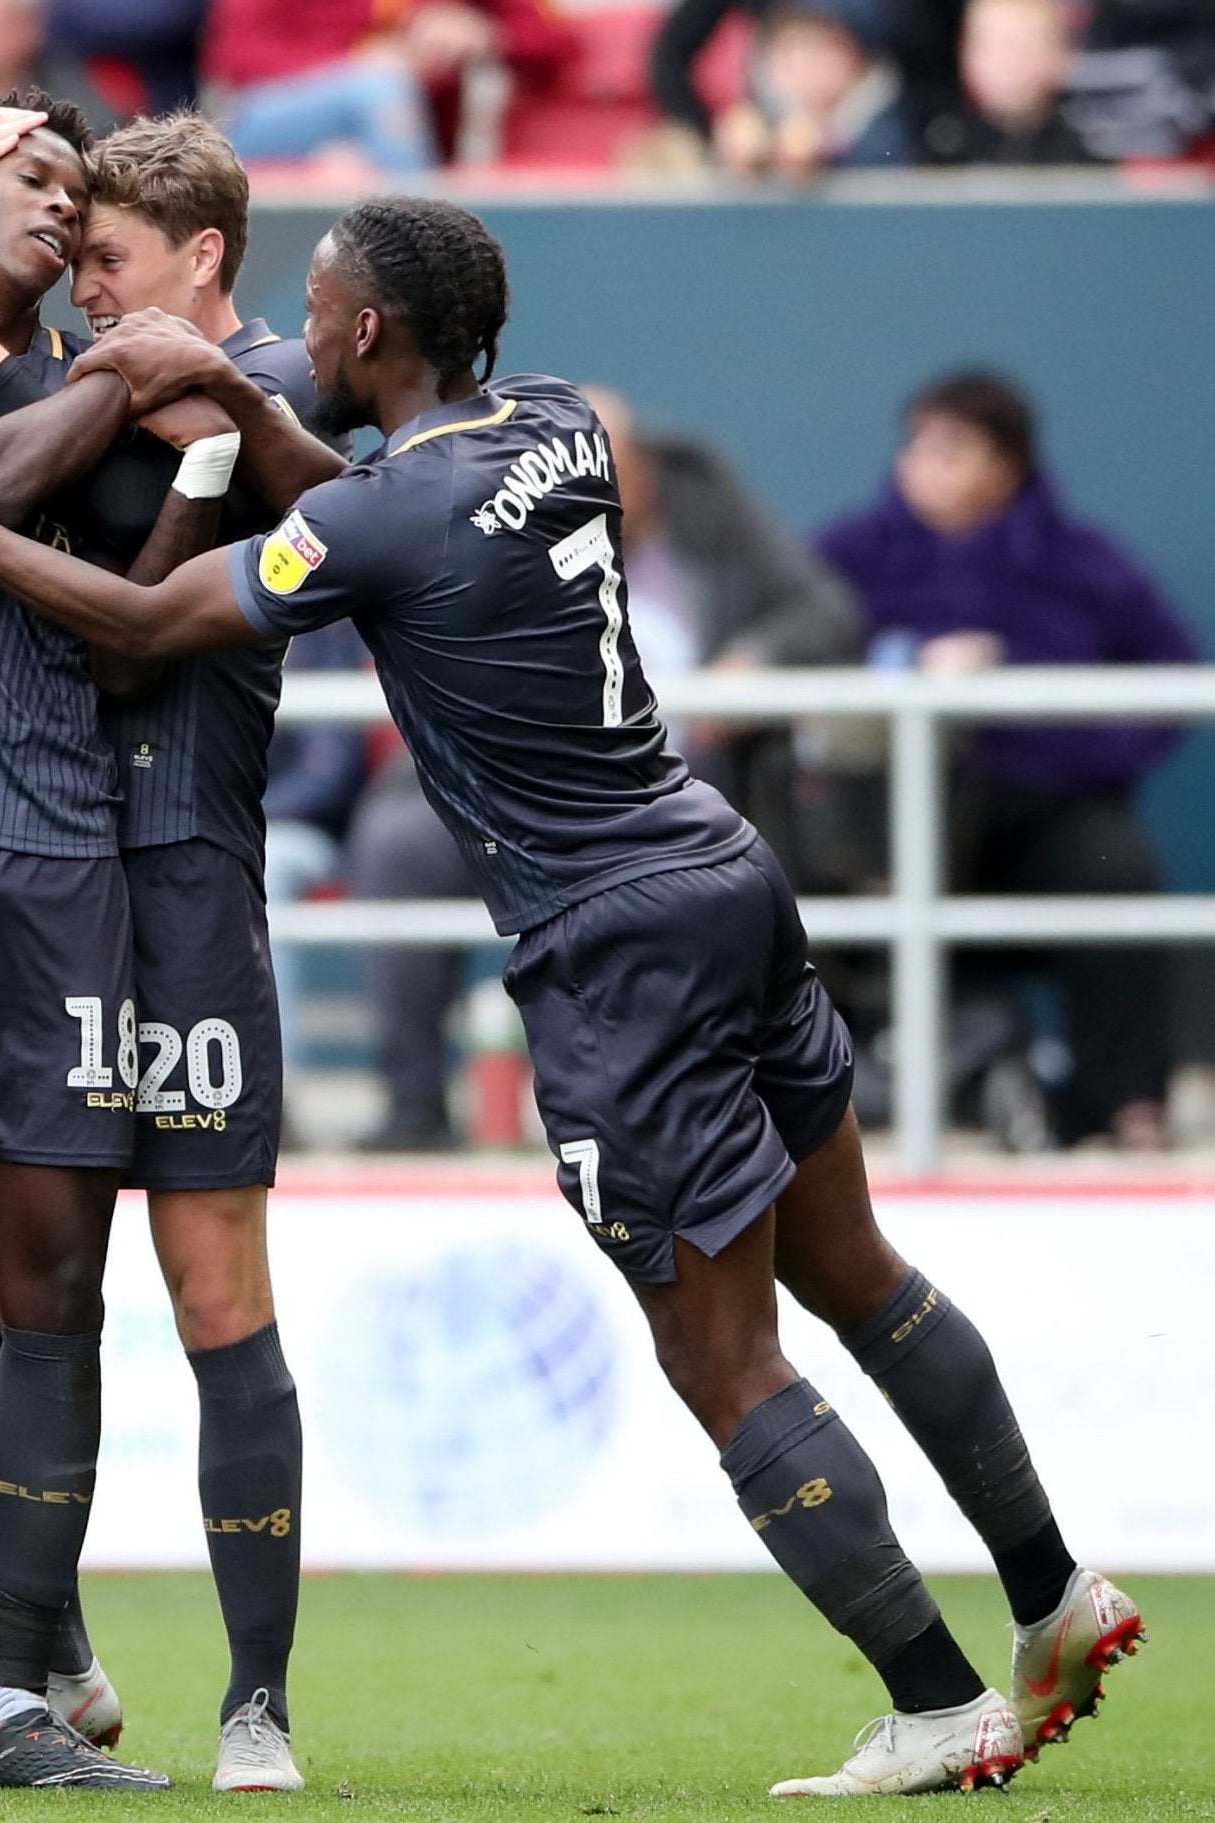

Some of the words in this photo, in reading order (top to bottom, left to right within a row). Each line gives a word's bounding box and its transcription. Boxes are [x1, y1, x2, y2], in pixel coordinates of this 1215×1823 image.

[494, 431, 609, 530] ONOMAH
[296, 538, 320, 564] bet
[548, 513, 625, 729] 7
[64, 997, 139, 1089] 18
[135, 1017, 243, 1113] 20
[155, 1108, 227, 1132] ELEV8
[559, 1138, 603, 1224] 7
